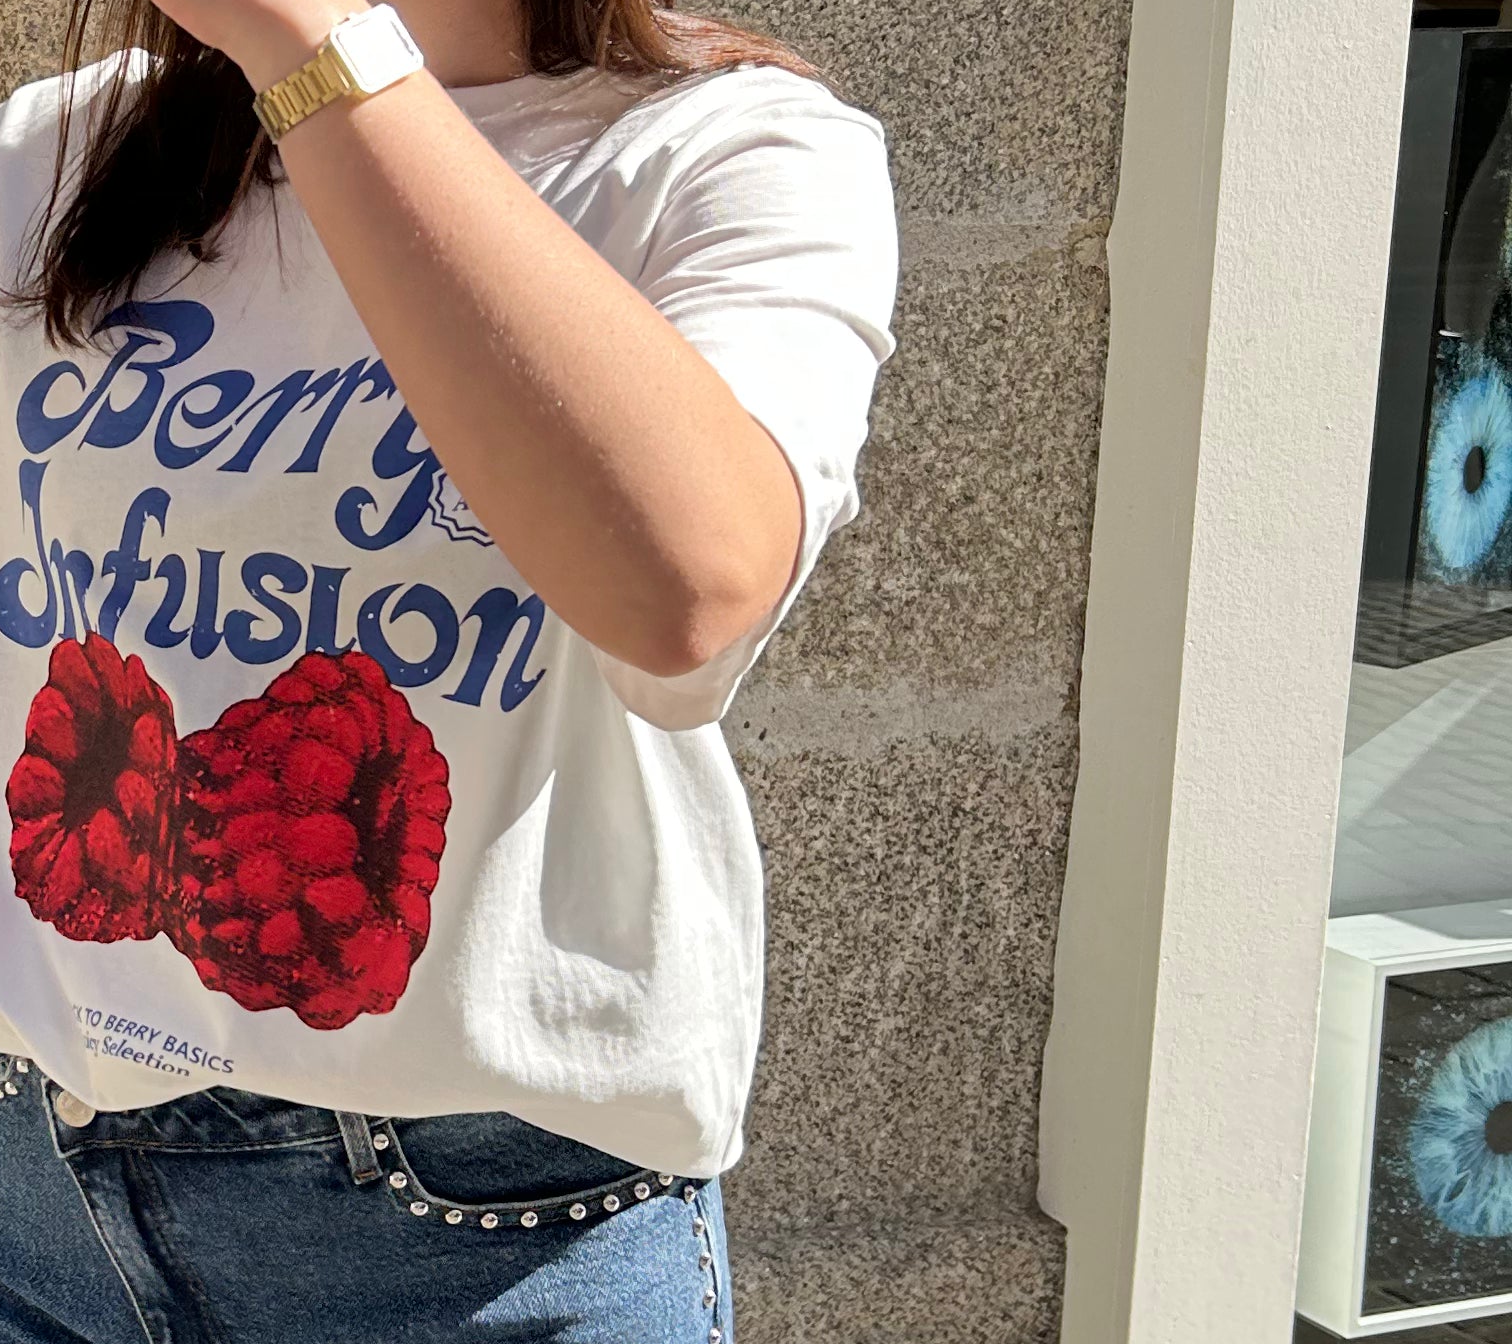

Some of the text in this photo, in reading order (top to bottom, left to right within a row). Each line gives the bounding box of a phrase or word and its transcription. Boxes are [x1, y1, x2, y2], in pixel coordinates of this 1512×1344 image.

[16, 300, 443, 551] Berry
[85, 1007, 102, 1027] TO
[104, 1014, 162, 1044] BERRY
[162, 1035, 235, 1074] BASICS
